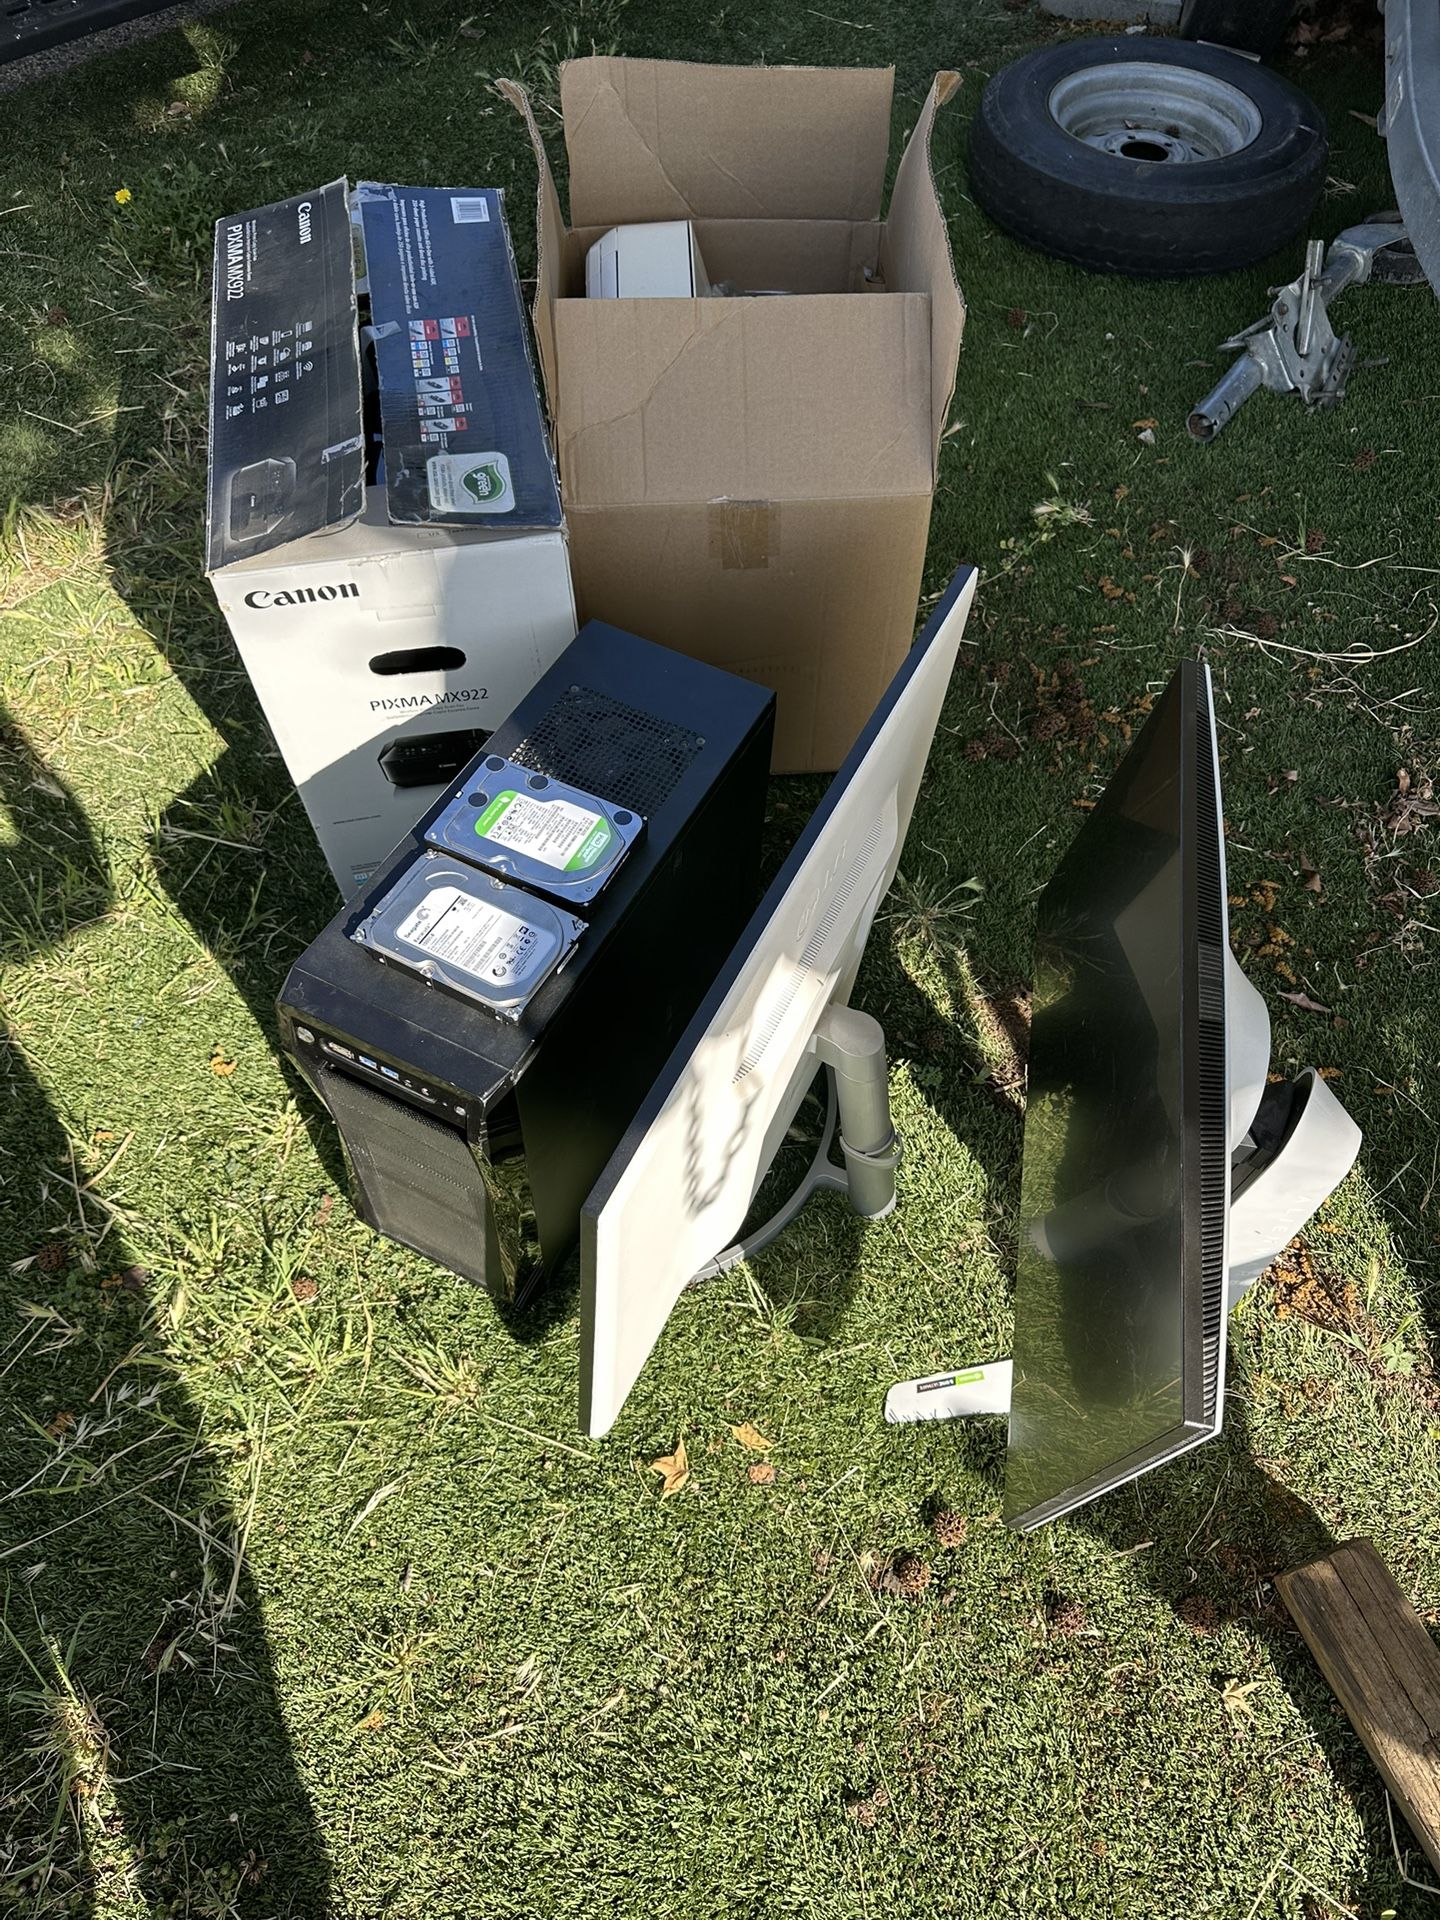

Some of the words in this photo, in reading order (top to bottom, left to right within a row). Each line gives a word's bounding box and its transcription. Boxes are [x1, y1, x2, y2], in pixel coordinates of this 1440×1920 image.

[297, 202, 312, 245] Canon
[227, 224, 244, 266] PIXMA
[227, 264, 244, 301] MX922
[472, 472, 489, 496] green
[244, 581, 360, 609] Canon
[370, 695, 433, 711] PIXMA
[435, 688, 488, 704] MX922
[403, 919, 422, 939] Seagate
